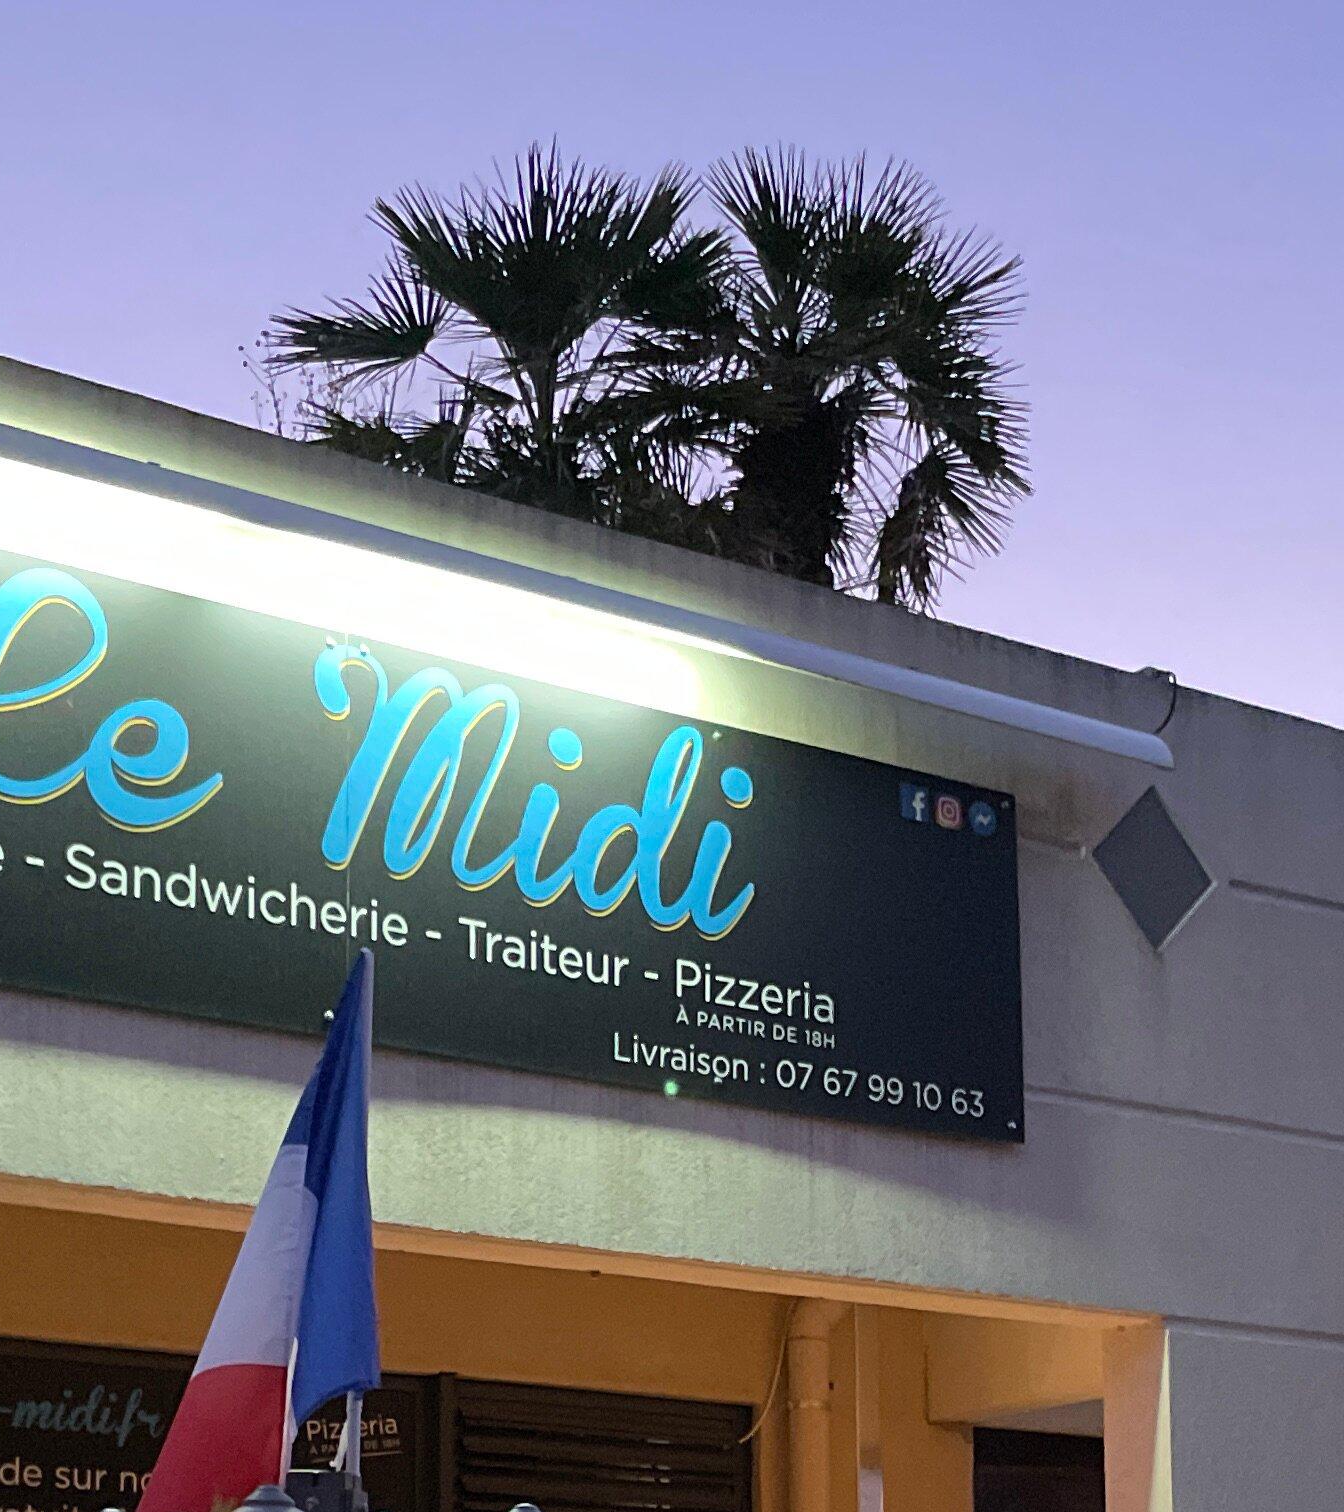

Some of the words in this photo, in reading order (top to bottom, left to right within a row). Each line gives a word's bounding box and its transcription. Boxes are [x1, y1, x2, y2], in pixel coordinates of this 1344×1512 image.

[313, 643, 755, 941] Midi
[65, 844, 409, 946] Sandwicherie
[458, 917, 629, 986] Traiteur
[675, 959, 835, 1024] Pizzeria
[676, 1003, 690, 1025] À
[697, 1010, 766, 1039] PARTIR
[773, 1022, 798, 1044] DE
[805, 1029, 836, 1050] 18H
[613, 1032, 749, 1083] Livraison
[775, 1060, 813, 1090] 07
[824, 1067, 858, 1097] 67
[867, 1074, 904, 1105] 99
[912, 1081, 942, 1111] 10
[951, 1087, 985, 1117] 63
[306, 1411, 399, 1442] Pizeria
[54, 1466, 108, 1491] sur
